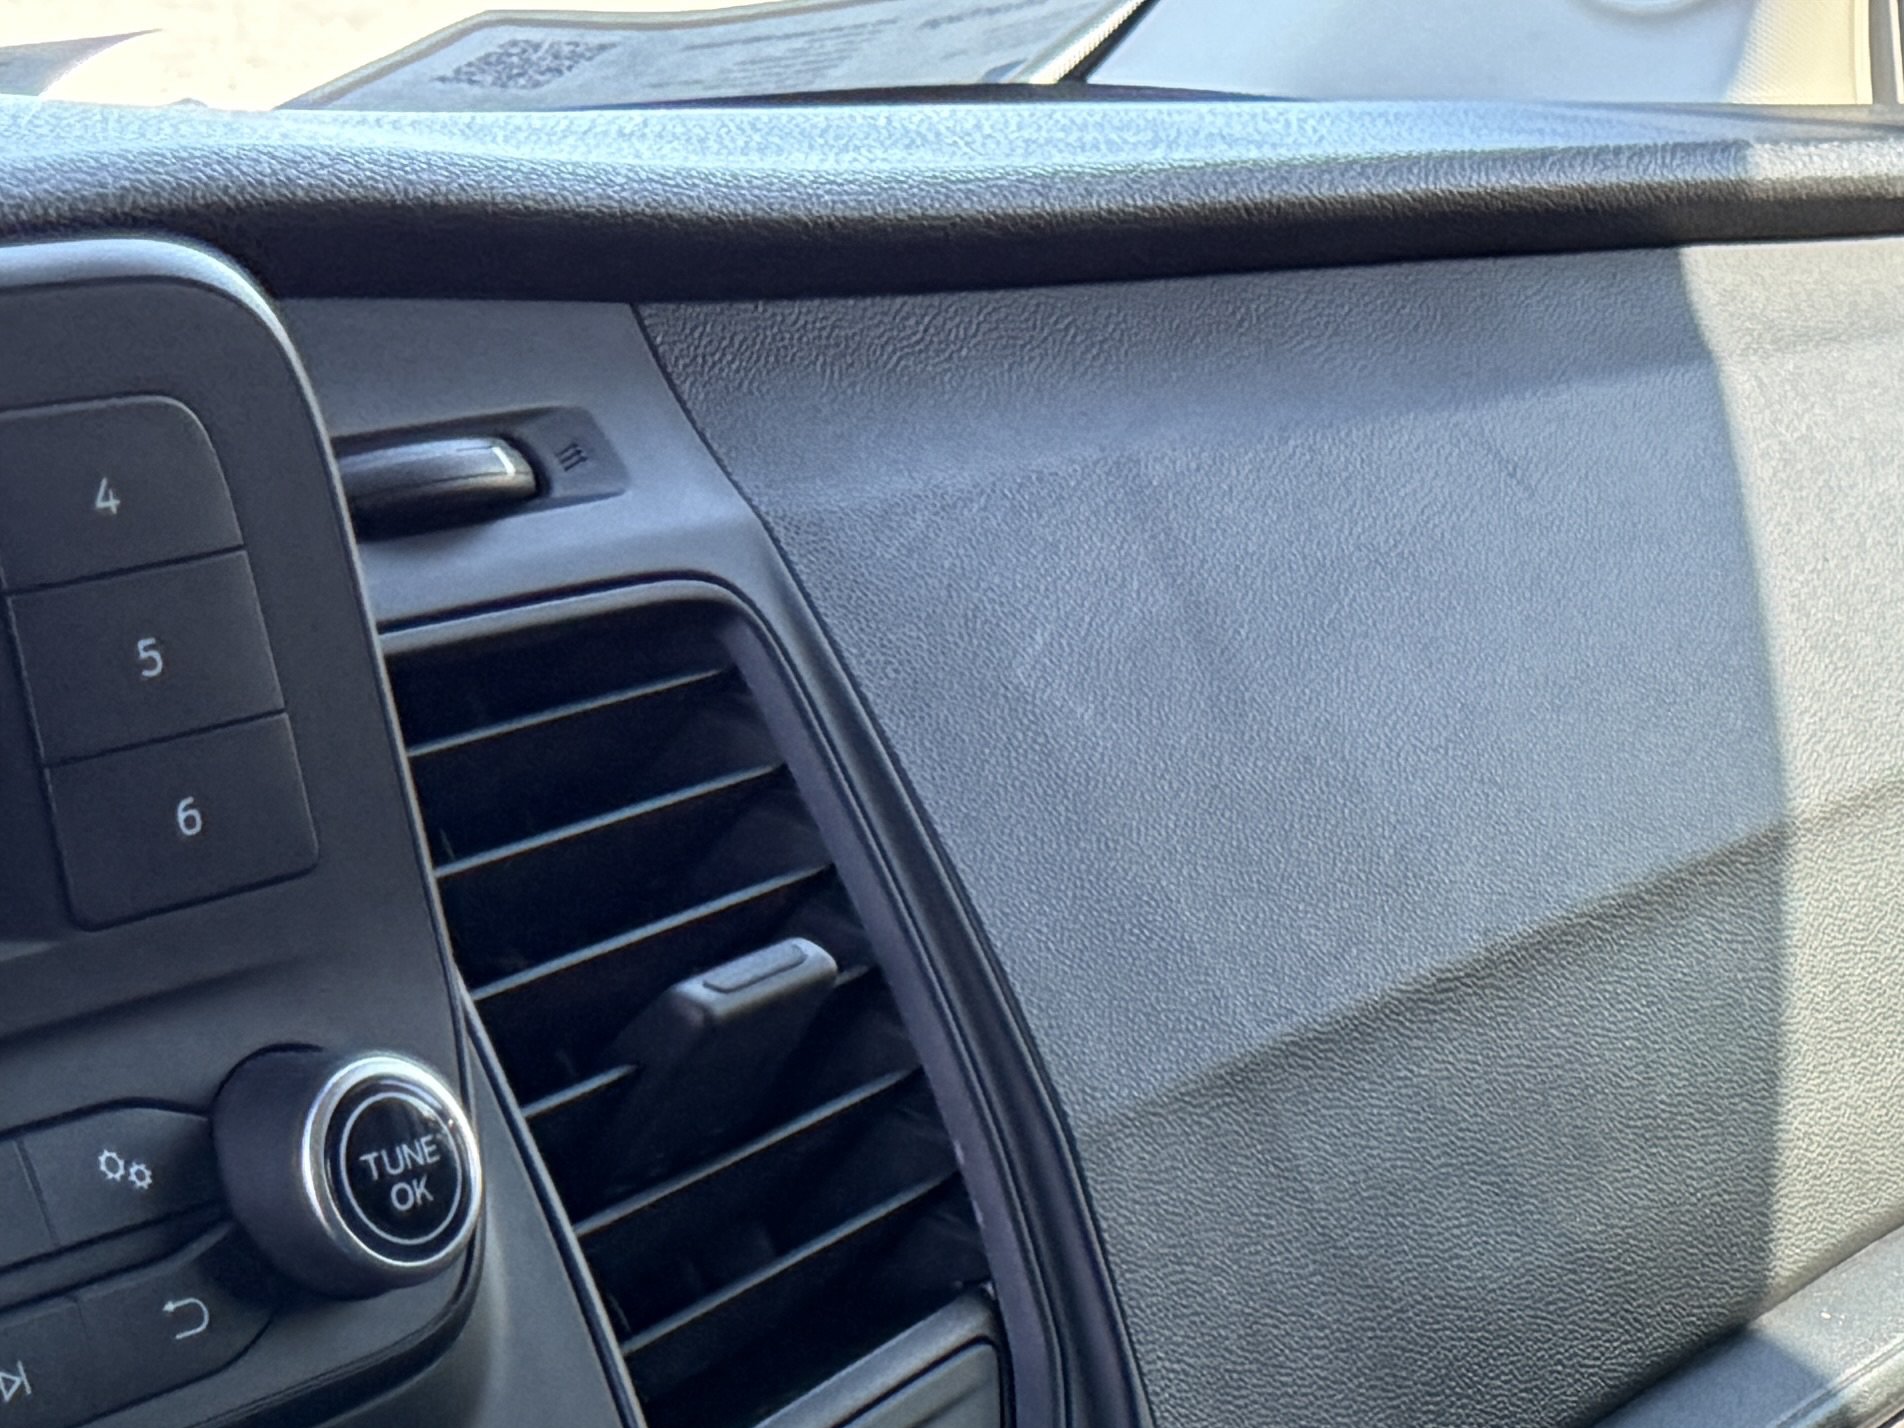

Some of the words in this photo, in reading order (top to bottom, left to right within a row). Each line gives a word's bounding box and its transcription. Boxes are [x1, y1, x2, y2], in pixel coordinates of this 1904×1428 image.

[96, 477, 120, 513] 4
[136, 637, 164, 679] 5
[176, 796, 203, 837] 6
[359, 1135, 440, 1181] TUNE
[389, 1174, 434, 1211] OK
